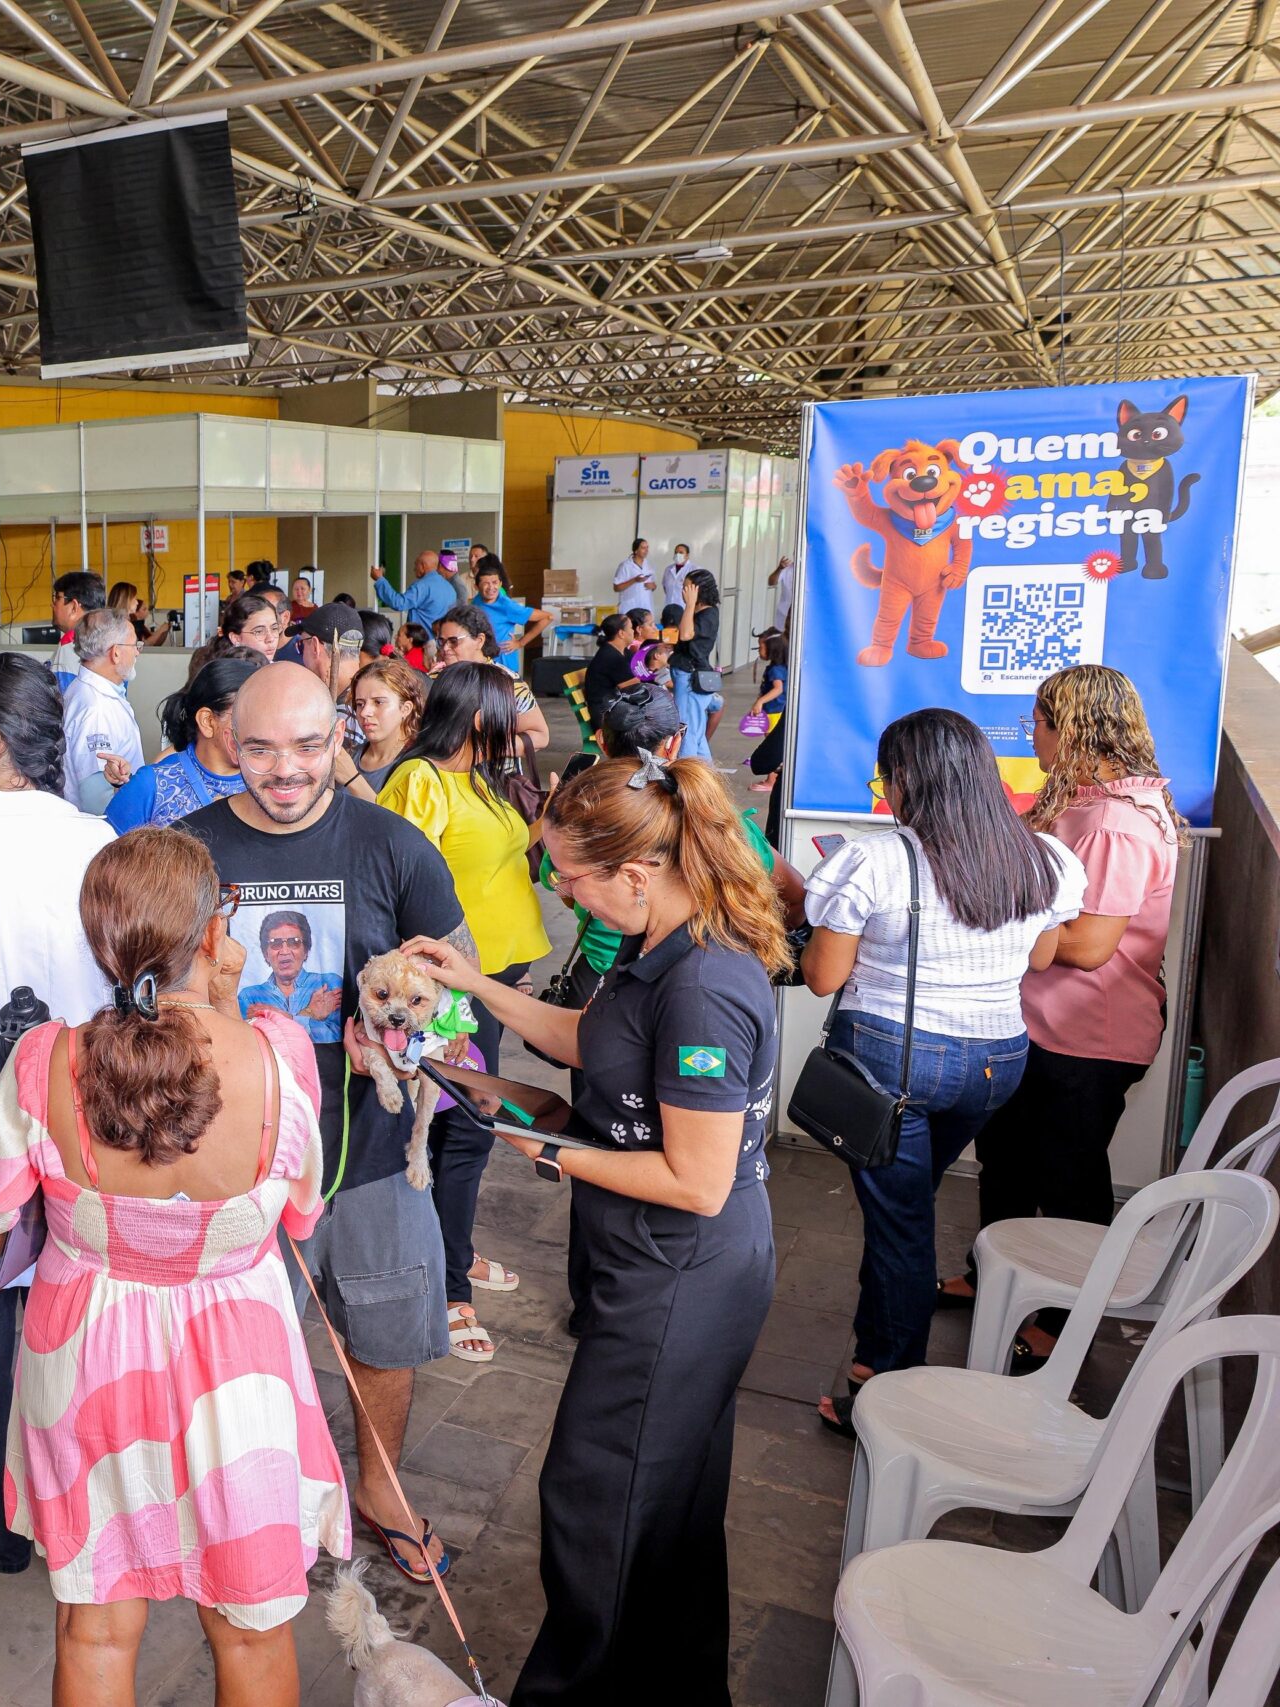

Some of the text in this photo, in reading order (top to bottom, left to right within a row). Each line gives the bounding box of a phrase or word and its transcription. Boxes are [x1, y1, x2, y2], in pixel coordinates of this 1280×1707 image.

[958, 431, 1122, 474] Quem
[581, 467, 610, 480] Sin
[648, 478, 696, 490] GATOS
[1004, 470, 1149, 503] ama,
[956, 502, 1168, 550] registra
[144, 530, 165, 540] SDA
[294, 884, 340, 898] MARS
